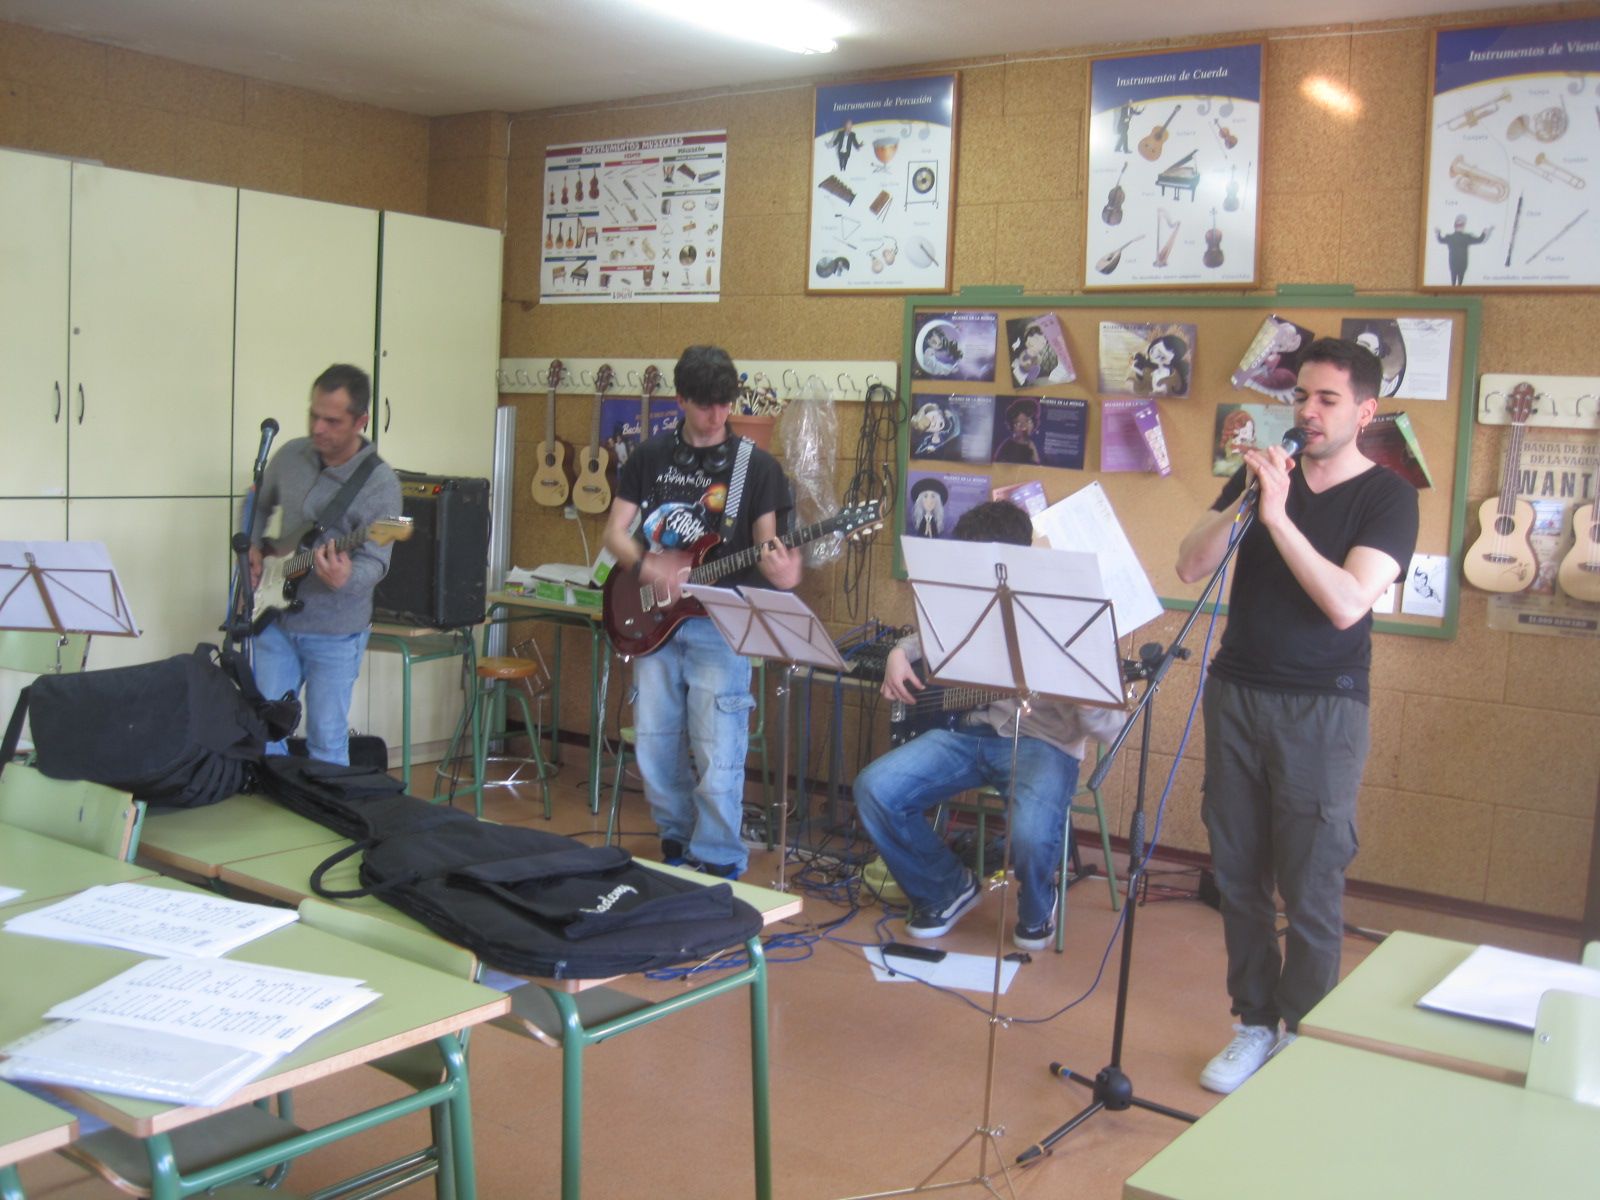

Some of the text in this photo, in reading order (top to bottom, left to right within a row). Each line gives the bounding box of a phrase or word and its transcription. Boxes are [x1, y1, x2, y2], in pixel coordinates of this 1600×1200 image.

[1468, 45, 1545, 61] Instrumentos
[1548, 42, 1563, 55] de
[1116, 66, 1228, 87] Instrumentos de Cuerda
[833, 94, 932, 112] Instrumentos de Percusión
[1530, 453, 1545, 465] DE
[1547, 455, 1560, 466] LA
